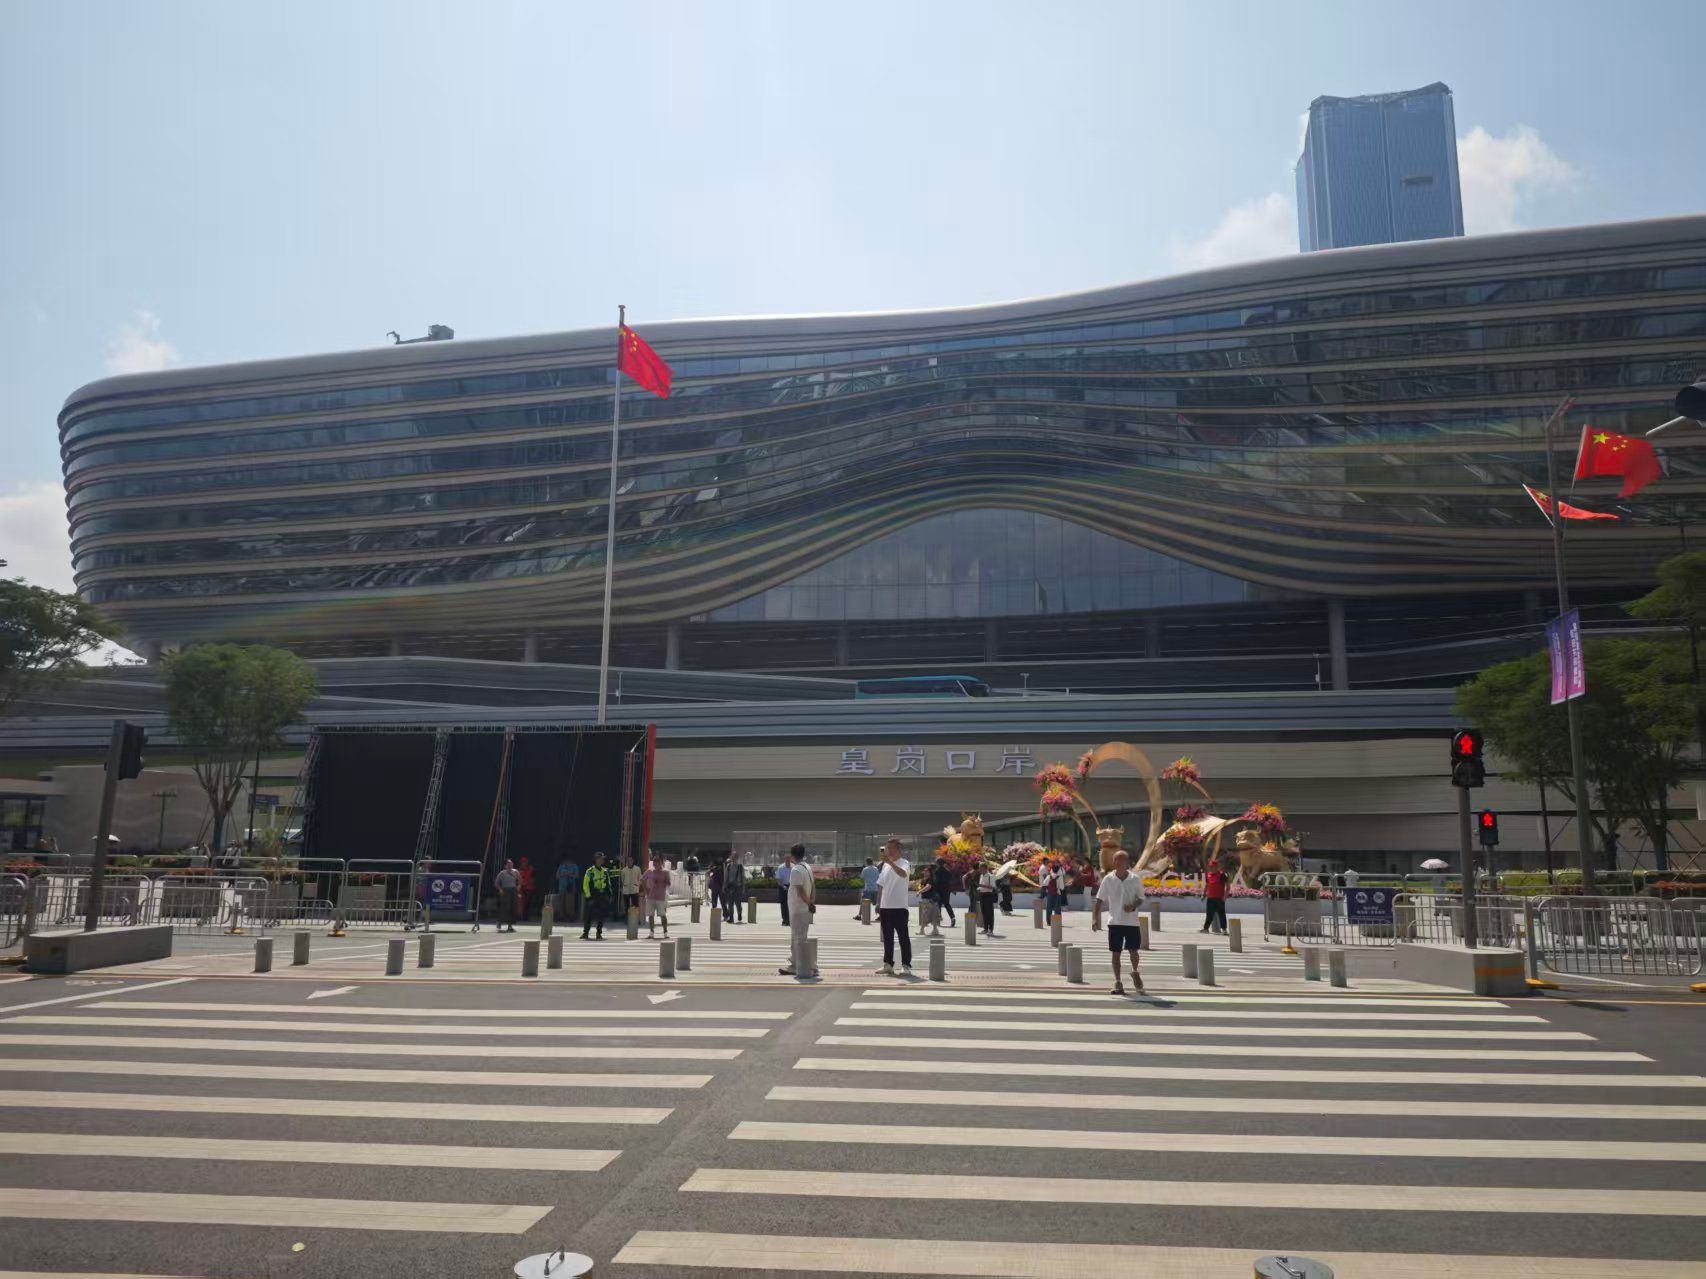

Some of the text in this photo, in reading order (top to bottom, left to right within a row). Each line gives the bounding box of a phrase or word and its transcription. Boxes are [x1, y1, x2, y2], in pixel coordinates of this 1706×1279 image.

[835, 745, 1036, 775] 皇岗口岸
[1160, 869, 1249, 892] CHIA
